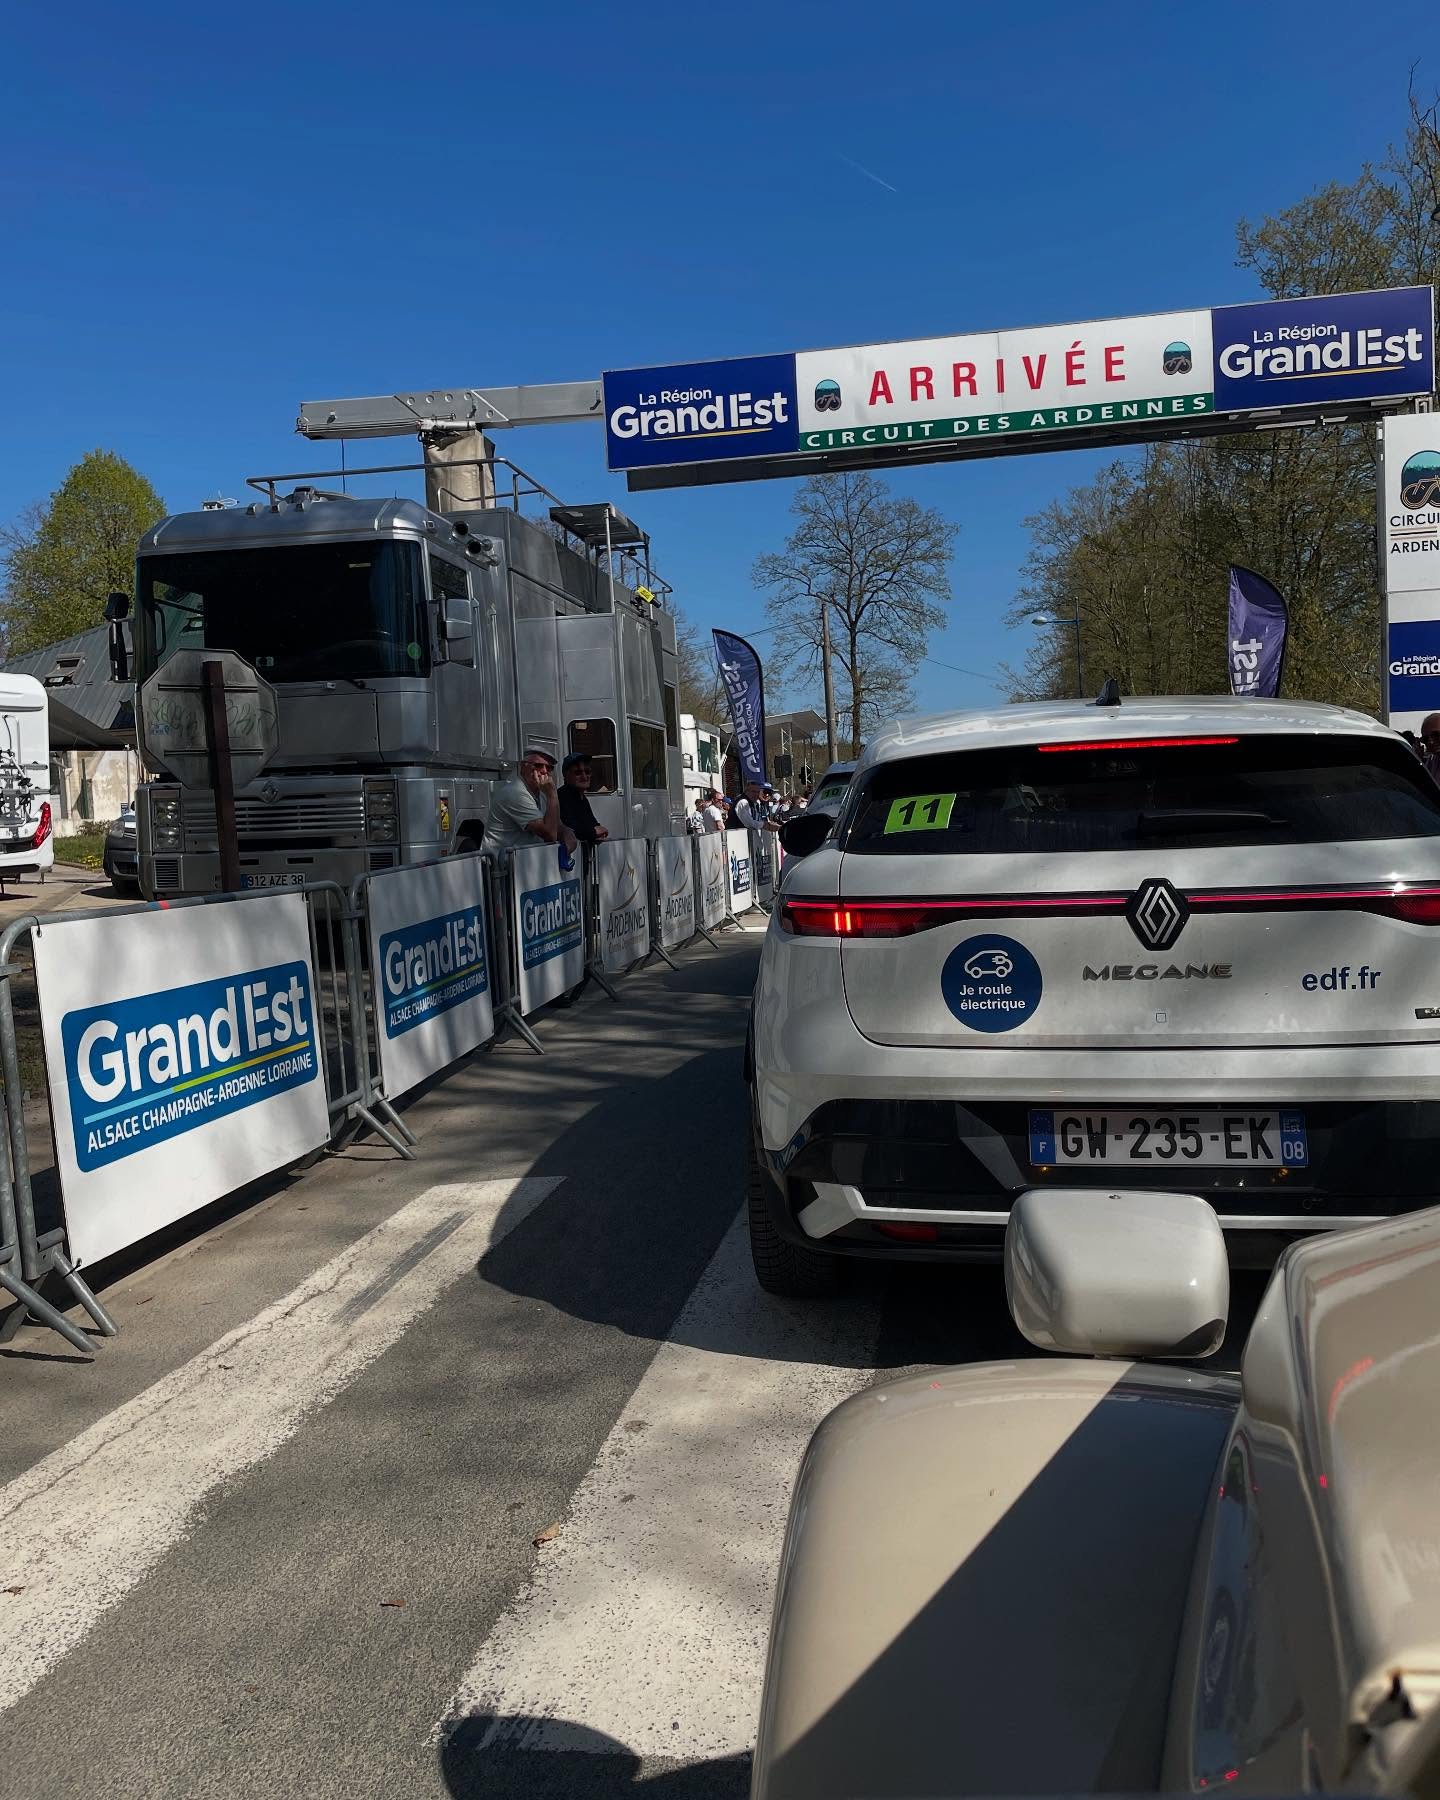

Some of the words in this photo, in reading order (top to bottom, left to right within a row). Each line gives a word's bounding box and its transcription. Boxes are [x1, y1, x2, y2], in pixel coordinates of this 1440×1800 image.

[1253, 329, 1275, 344] La
[1278, 323, 1337, 343] Région
[868, 340, 1126, 406] ARRIVÉE
[639, 393, 657, 406] La
[661, 388, 712, 405] Région
[806, 423, 934, 447] CIRCUIT
[953, 415, 1009, 434] DES
[1030, 396, 1207, 427] ARDENNES
[898, 797, 940, 826] 11
[248, 875, 266, 886] 912
[270, 875, 288, 886] AZE
[1082, 962, 1233, 982] MEGANE
[1301, 965, 1382, 991] edf.fr
[960, 984, 975, 997] Je
[977, 983, 1012, 996] roule
[960, 996, 1026, 1012] électrique
[390, 1007, 412, 1027] ALSACE
[87, 1115, 141, 1154] ALSACE
[142, 1071, 267, 1130] CHAMPAGNE-ARDENNE
[267, 1052, 313, 1089] LORRAINE
[1039, 1141, 1047, 1153] F
[1060, 1117, 1275, 1160] GW-235-EK
[1283, 1140, 1305, 1160] 08
